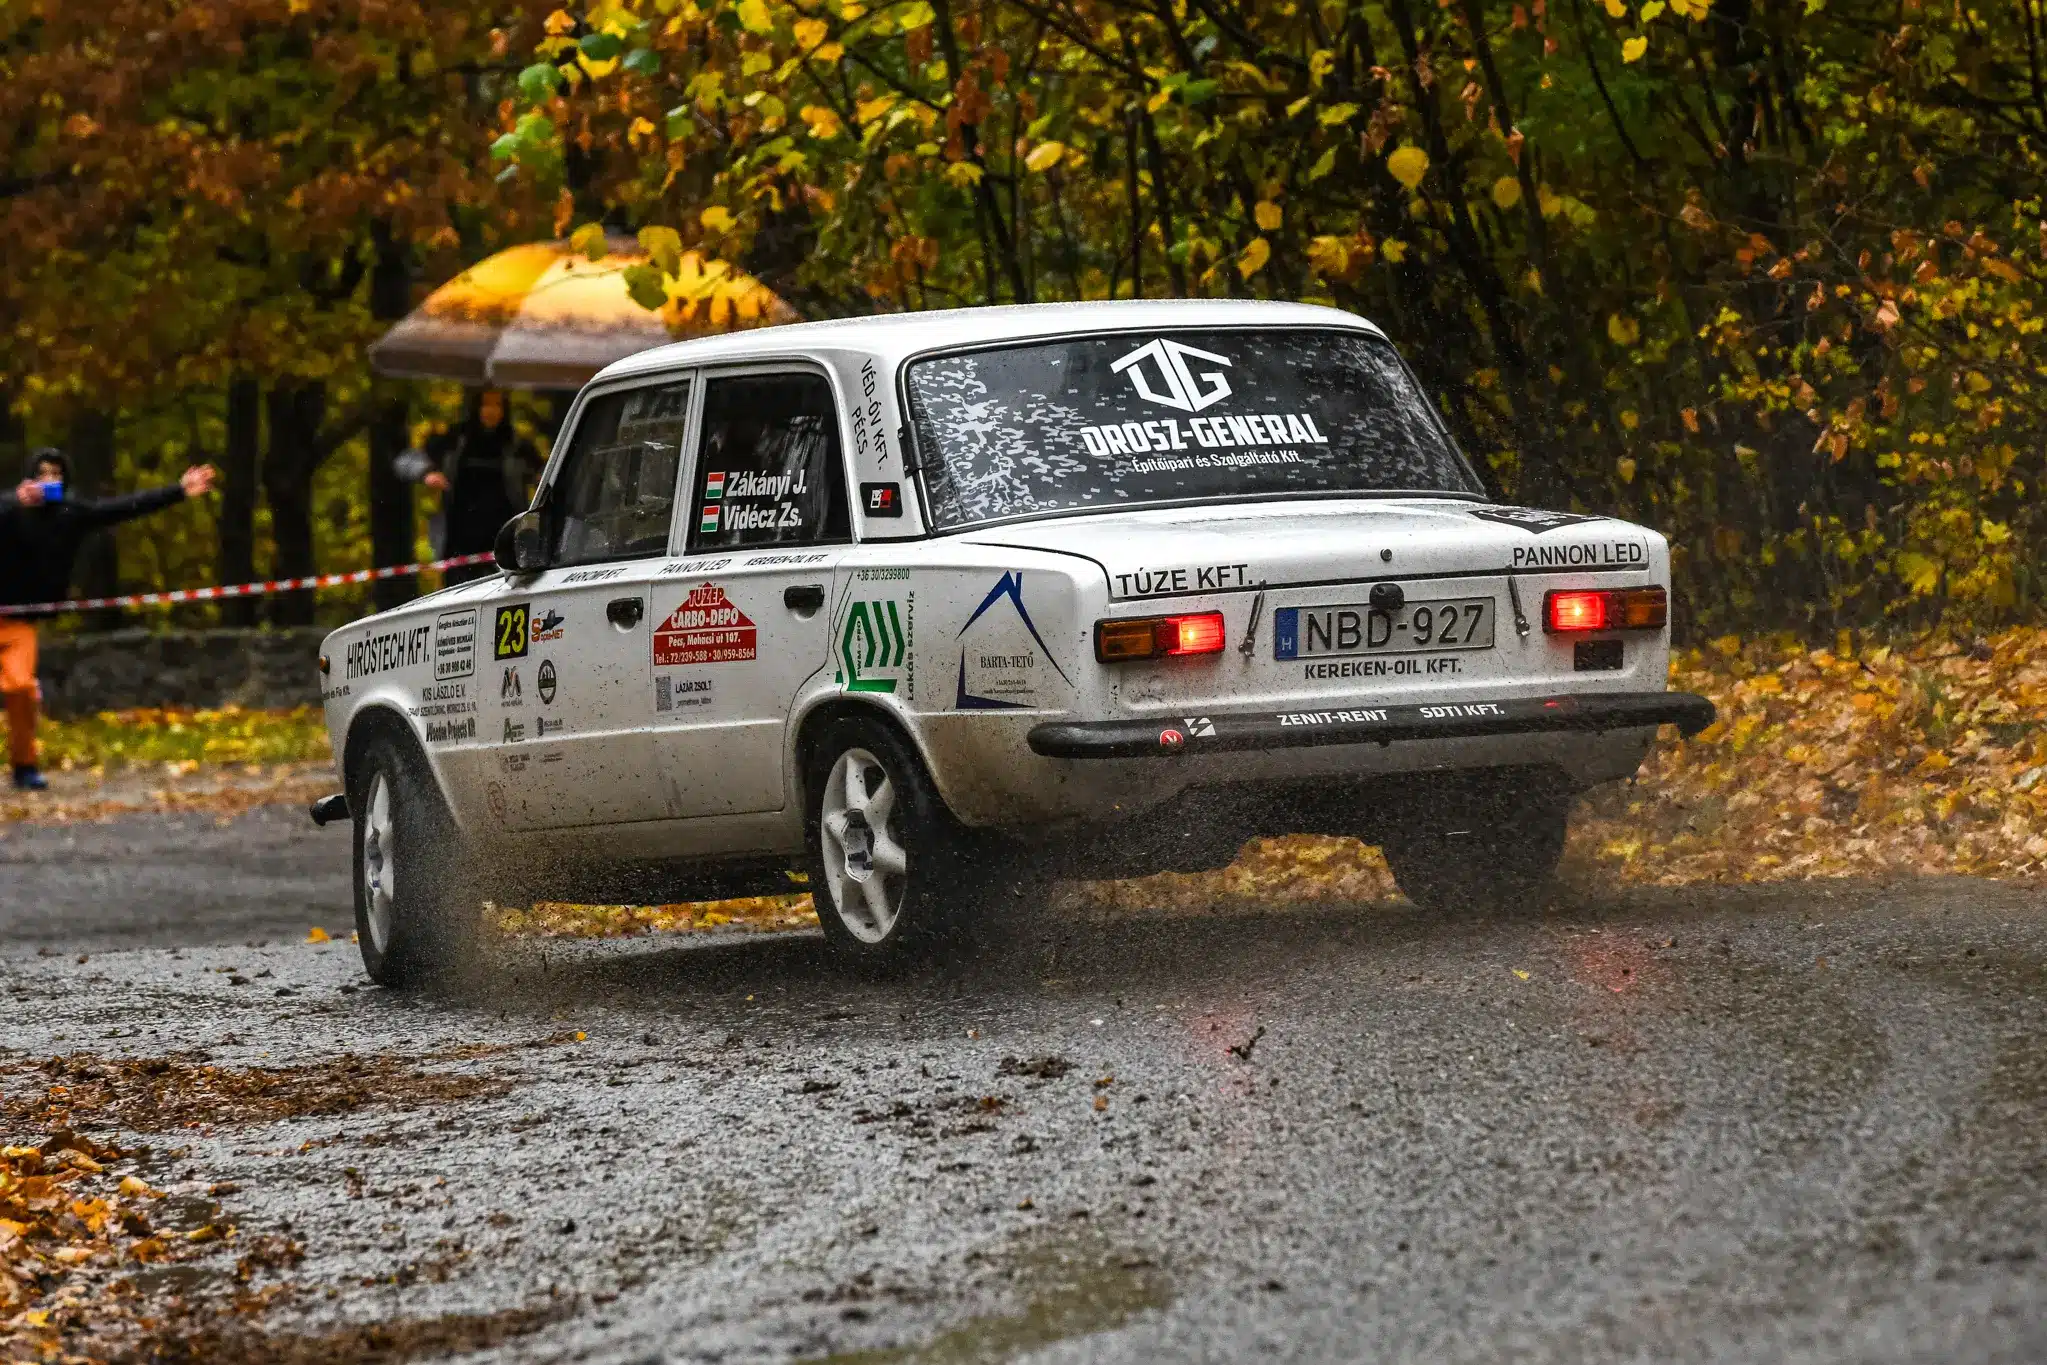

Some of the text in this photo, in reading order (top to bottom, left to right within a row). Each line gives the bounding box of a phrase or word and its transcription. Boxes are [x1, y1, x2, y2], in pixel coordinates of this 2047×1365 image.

[861, 358, 882, 427] VÉD-ÓV
[873, 428, 888, 470] KFT.
[852, 405, 868, 455] PÉCS
[1080, 413, 1328, 457] OROSZ-GENERAL
[1132, 449, 1305, 475] Építőipari és Szolgáltató Kft.
[726, 469, 807, 503] Zákányi J.
[723, 502, 802, 531] Vidécz Zs.
[656, 558, 732, 576] PANNON LED
[1513, 543, 1642, 566] PANNON LED
[857, 568, 910, 581] +36 30/3299800
[1115, 563, 1253, 595] TÚZE KFT.
[670, 607, 739, 629] CARBO-DEPO
[907, 590, 915, 648] szerviz
[1307, 603, 1484, 651] NBD-927
[497, 608, 525, 655] 23
[687, 632, 715, 646] Mohácsi
[725, 632, 741, 643] 107.
[1281, 637, 1292, 651] H
[407, 625, 430, 666] KFT.
[1305, 658, 1462, 679] KEREKEN-OIL KFT.
[422, 687, 432, 701] KIS
[675, 680, 712, 693] LÁZÁR ZSOLT
[1276, 703, 1505, 726] ZENIT-RENT SDTI KFT.
